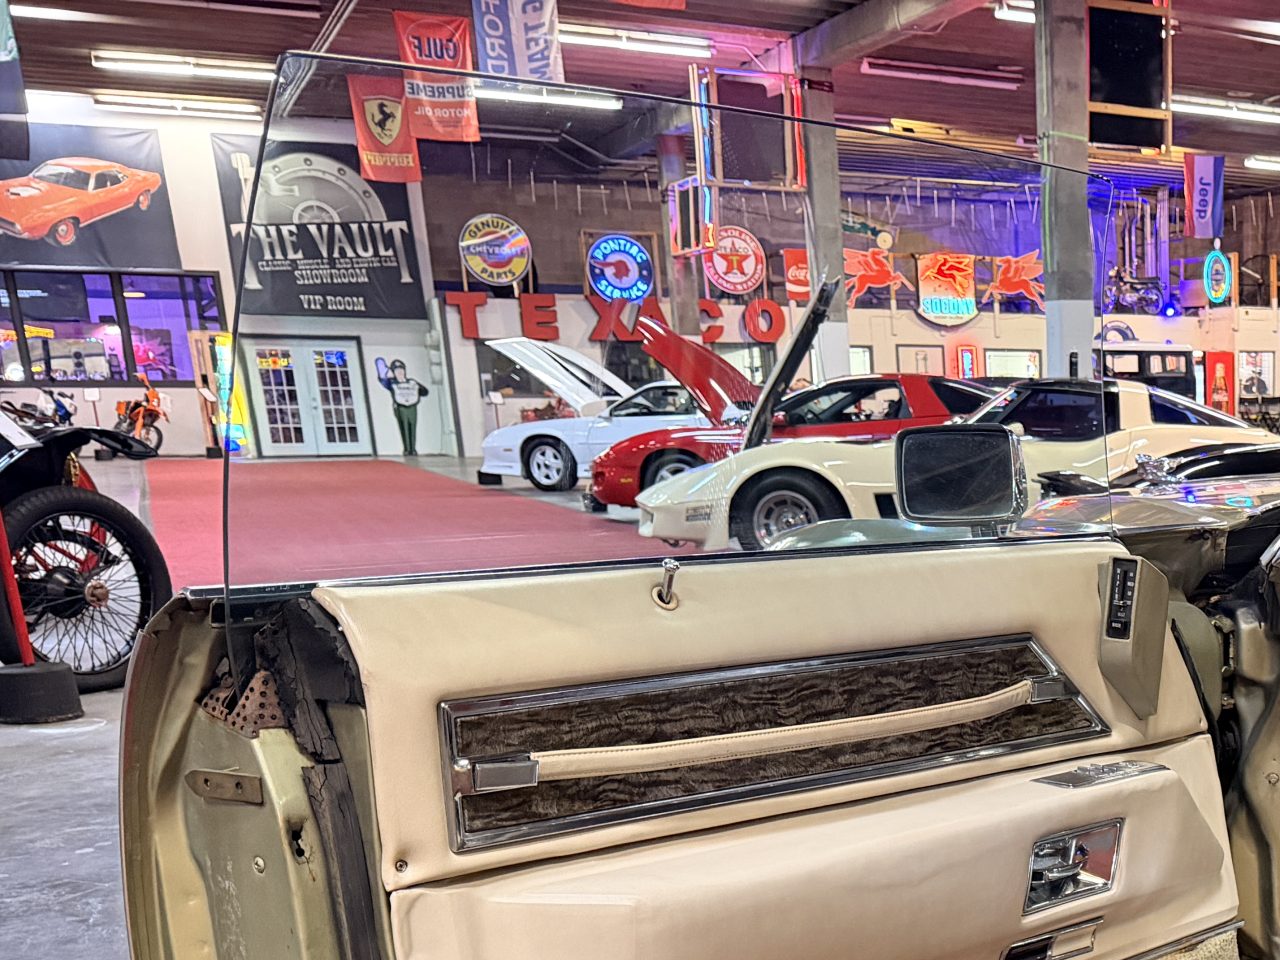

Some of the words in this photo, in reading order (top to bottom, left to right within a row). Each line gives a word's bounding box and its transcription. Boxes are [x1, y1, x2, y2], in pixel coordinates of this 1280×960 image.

[1195, 175, 1212, 221] Jeep
[230, 223, 304, 290] THE
[306, 220, 414, 283] VAULT
[592, 239, 647, 263] PONTIAC
[294, 269, 369, 285] SHOWROOM
[480, 266, 516, 281] PARTS
[596, 280, 648, 300] SERVICE
[299, 295, 324, 310] VIP
[326, 296, 366, 311] ROOM
